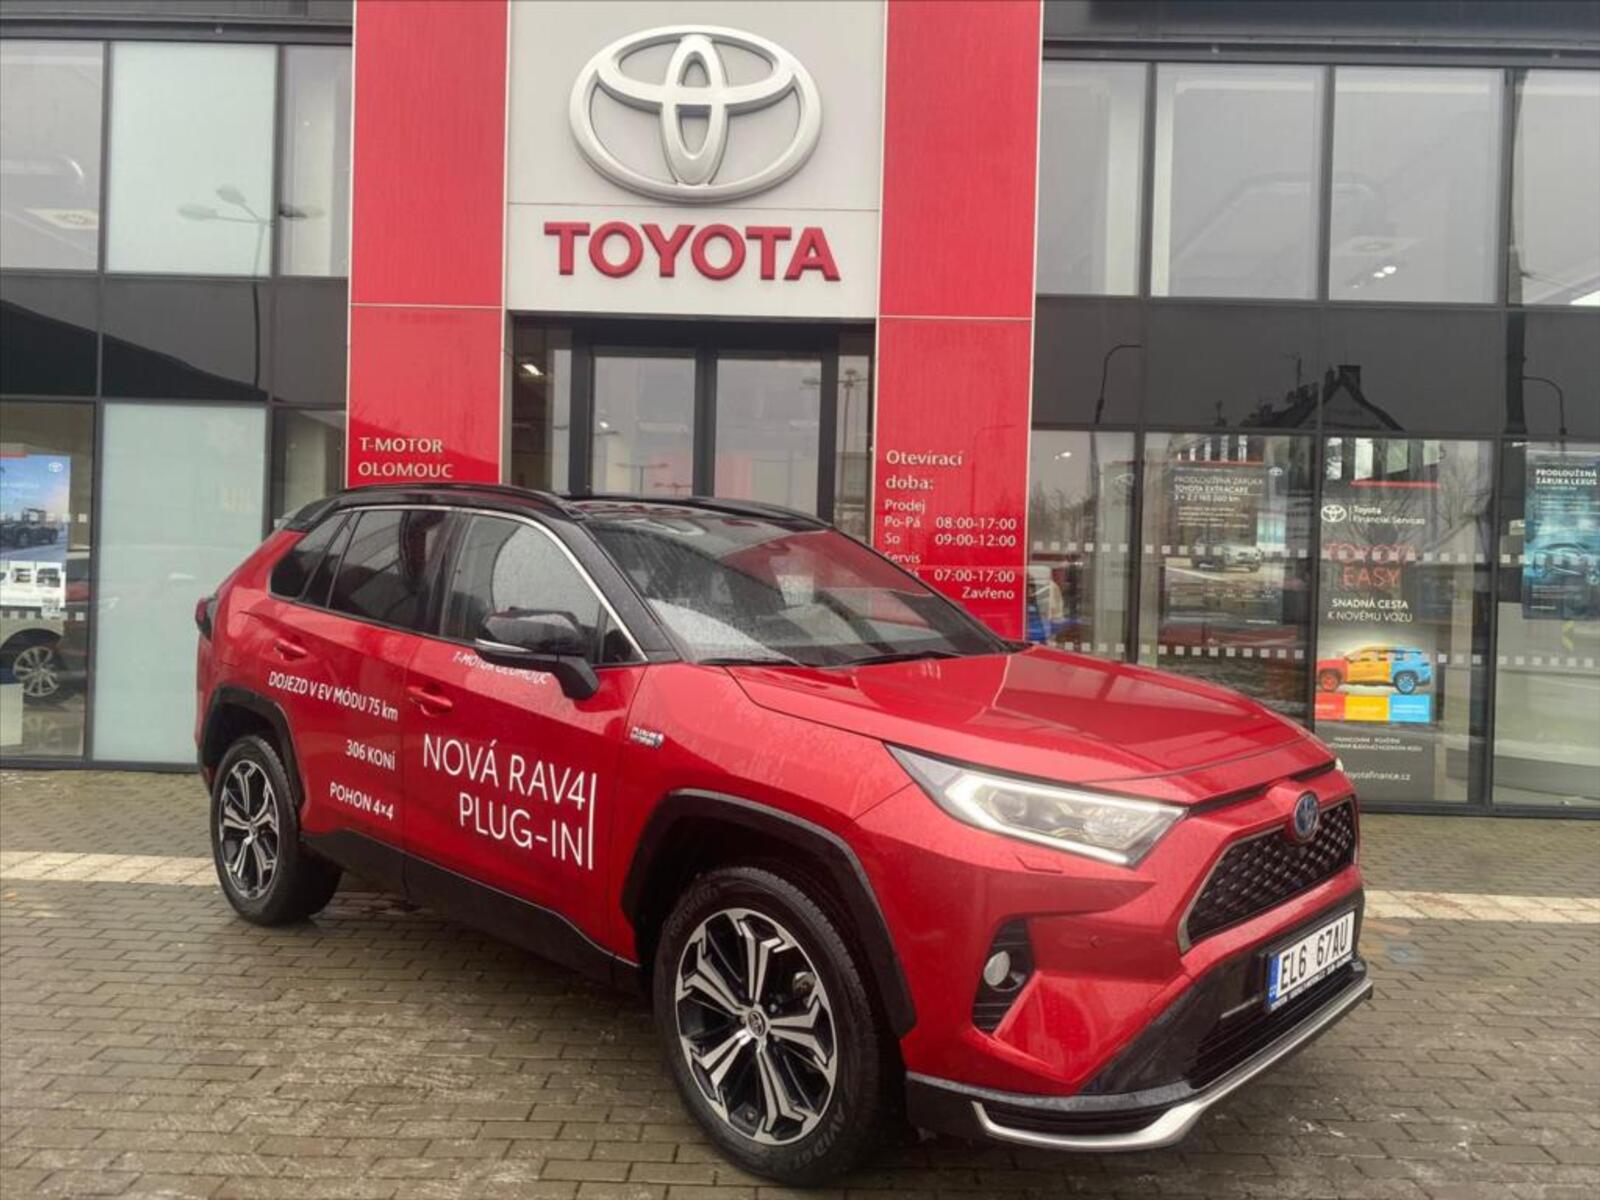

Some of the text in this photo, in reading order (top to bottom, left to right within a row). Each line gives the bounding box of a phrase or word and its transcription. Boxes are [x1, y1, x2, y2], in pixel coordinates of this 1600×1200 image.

[544, 221, 841, 282] TOYOTA
[358, 436, 443, 454] T-MOTOR
[885, 449, 963, 467] Otevírací
[358, 461, 454, 479] OLOMOUC
[885, 474, 934, 490] doba:
[1571, 478, 1597, 486] LEXUS
[884, 499, 925, 513] Prodej
[1353, 505, 1382, 515] Toyota
[884, 515, 1017, 530] Po-Pá 08:00-17:00
[1353, 515, 1425, 525] Financial Services
[884, 533, 1017, 547] So 09:00-12:00
[1324, 543, 1417, 564] TOYOTA
[934, 569, 1016, 582] 07:00-17:00
[1342, 567, 1401, 587] EASY
[962, 586, 1015, 600] Zavřeno
[1331, 597, 1409, 610] SNADNÁ CESTA
[1328, 609, 1413, 623] K NOVÉMU VOZU
[268, 671, 398, 722] DOJEZD V EV MÓDU 75 km
[345, 739, 396, 772] 306 KONÍ
[424, 733, 585, 811] NOVÁ RAV4
[329, 781, 372, 813] POHON
[459, 791, 583, 867] PLUG-IN
[1280, 944, 1307, 991] EL6
[1316, 918, 1349, 967] 67AU
